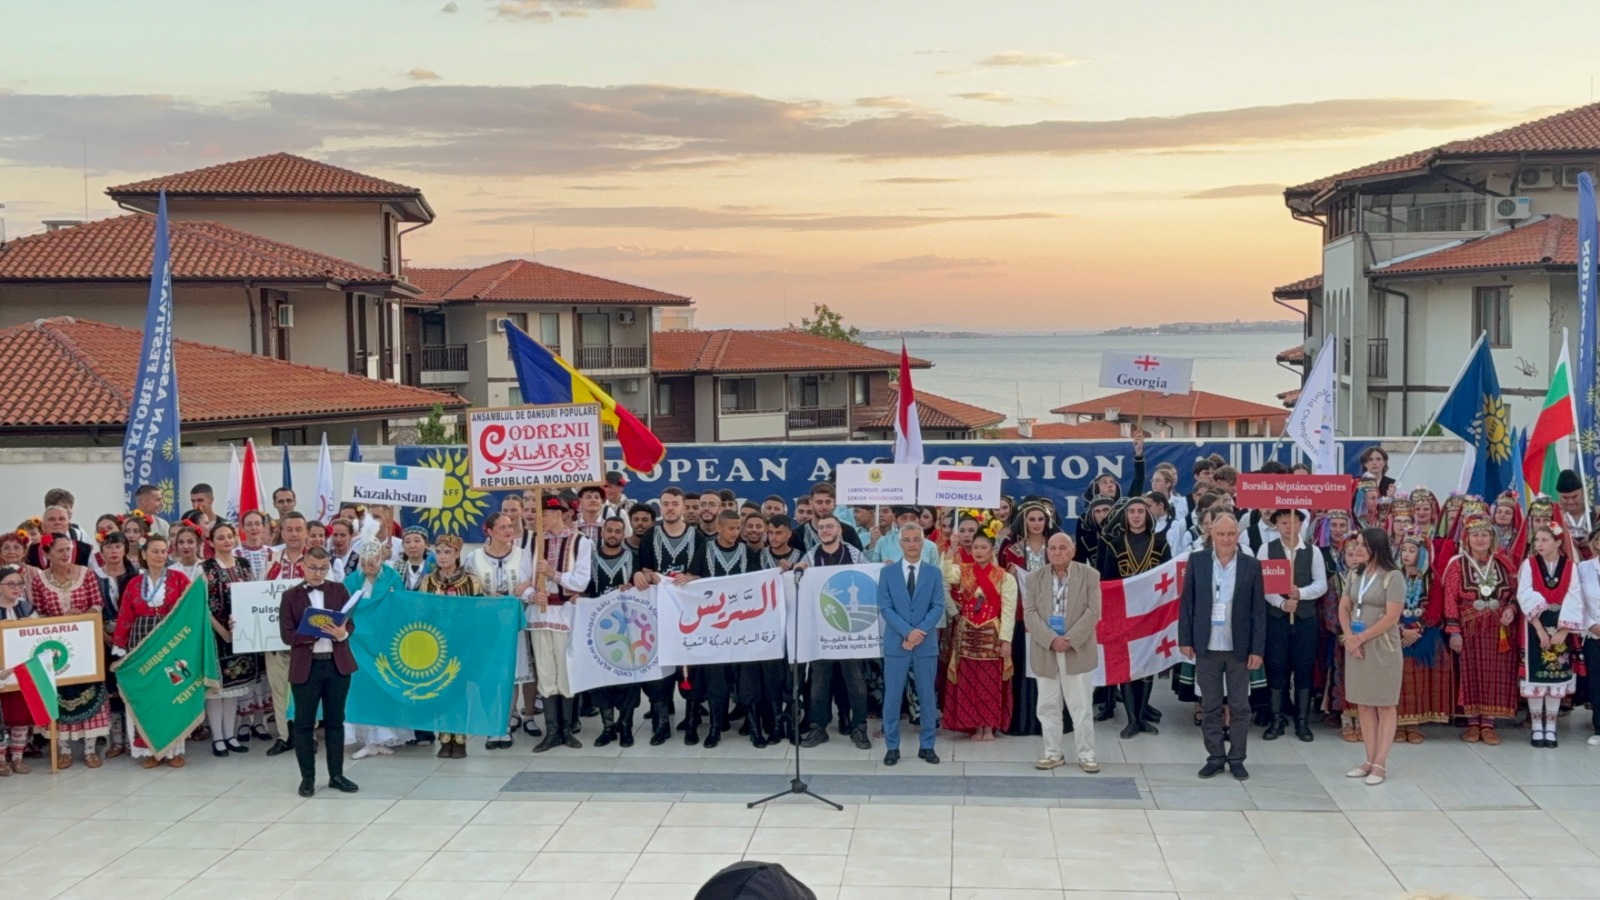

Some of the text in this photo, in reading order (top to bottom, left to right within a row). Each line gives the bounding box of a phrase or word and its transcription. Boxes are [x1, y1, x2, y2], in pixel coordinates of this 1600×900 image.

[1116, 373, 1168, 390] Georgia
[471, 406, 597, 422] ANSAMBLUL DE DANSURI POPULARE
[480, 473, 594, 487] REPUBLICA MOLDOVA
[1242, 481, 1274, 491] Borsika
[353, 485, 427, 503] Kazakhstan
[443, 488, 460, 497] AFF
[935, 492, 983, 502] INDONESIA
[1262, 566, 1286, 576] skola
[251, 605, 280, 614] Pulse
[19, 624, 79, 637] BULGARIA
